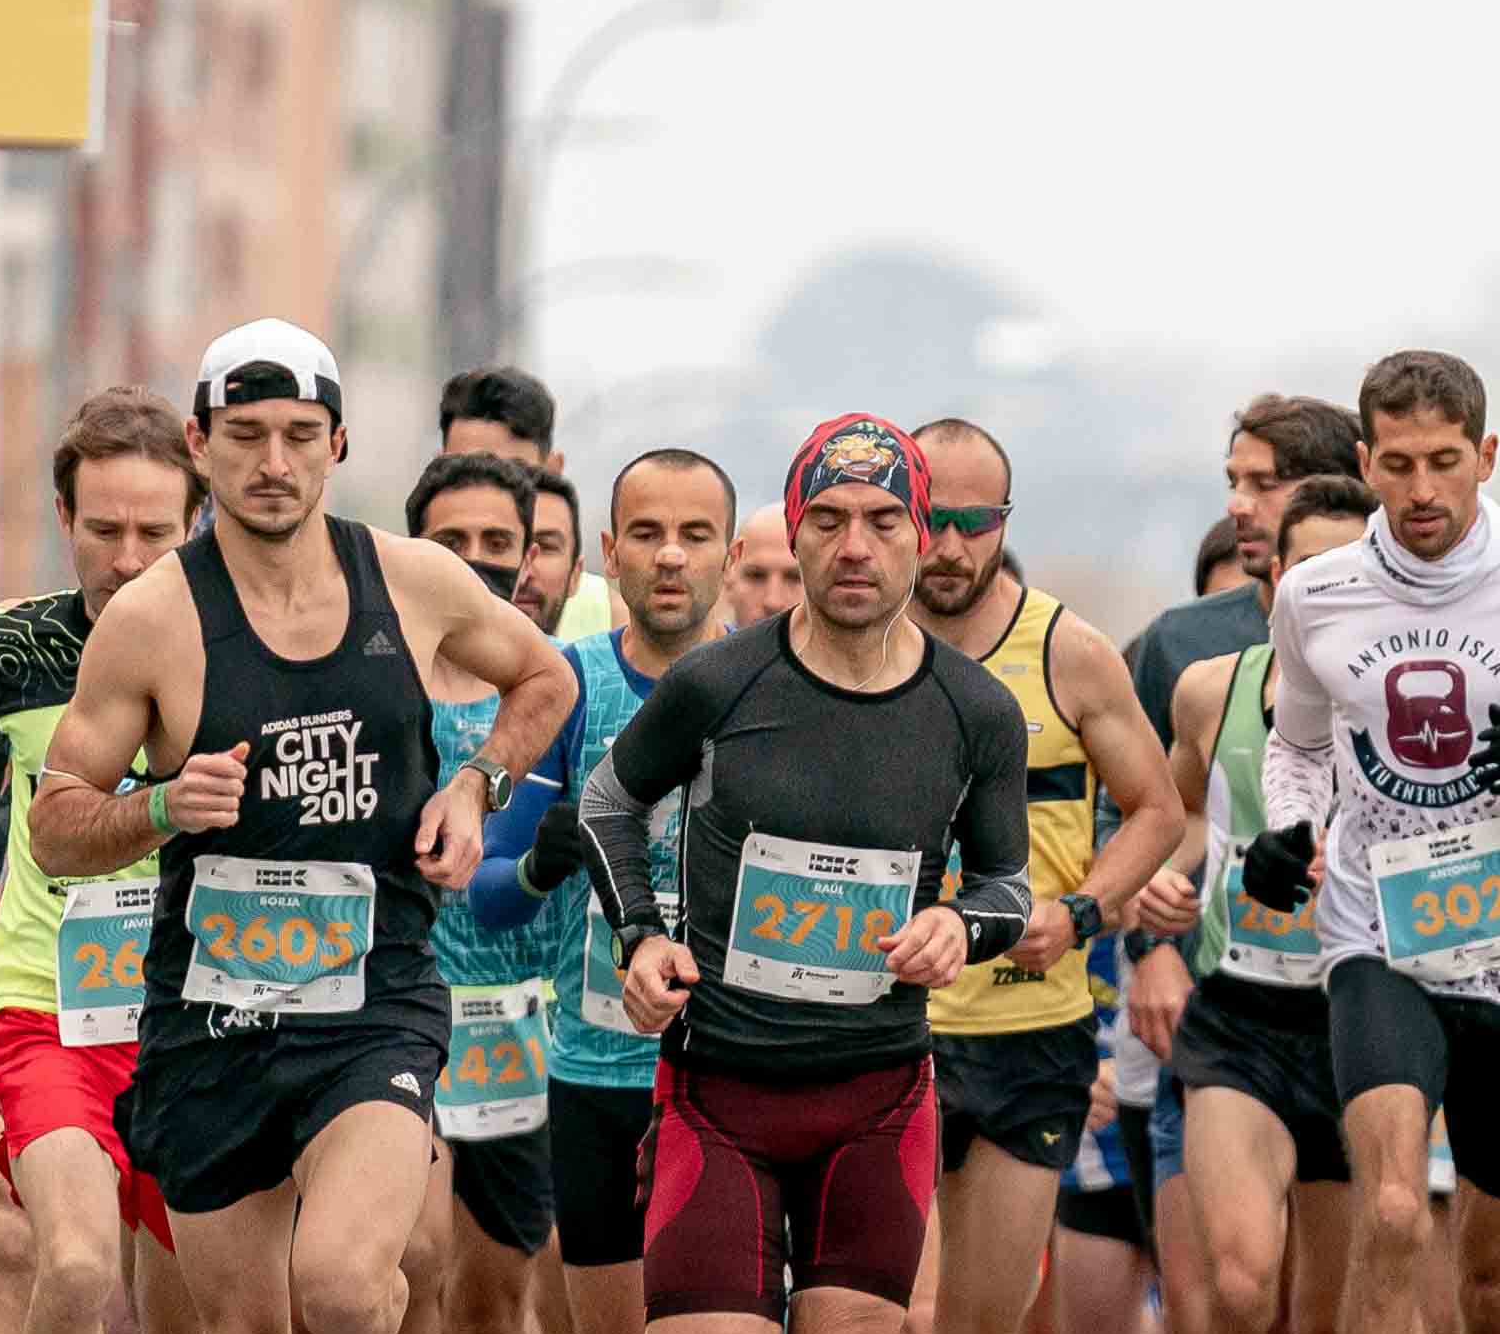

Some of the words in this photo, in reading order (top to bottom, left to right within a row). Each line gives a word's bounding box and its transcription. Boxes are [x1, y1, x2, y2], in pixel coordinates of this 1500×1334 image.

[1347, 628, 1450, 678] ANTONIO
[260, 720, 299, 736] ADIDAS
[300, 709, 353, 727] RUNNERS
[275, 720, 364, 765] CITY
[260, 752, 380, 801] NIGHT
[299, 786, 379, 826] 2019
[808, 853, 861, 876] 10K
[259, 894, 301, 909] BORJA
[752, 893, 895, 956] 2718
[74, 939, 147, 990] 26
[202, 914, 353, 969] 2605
